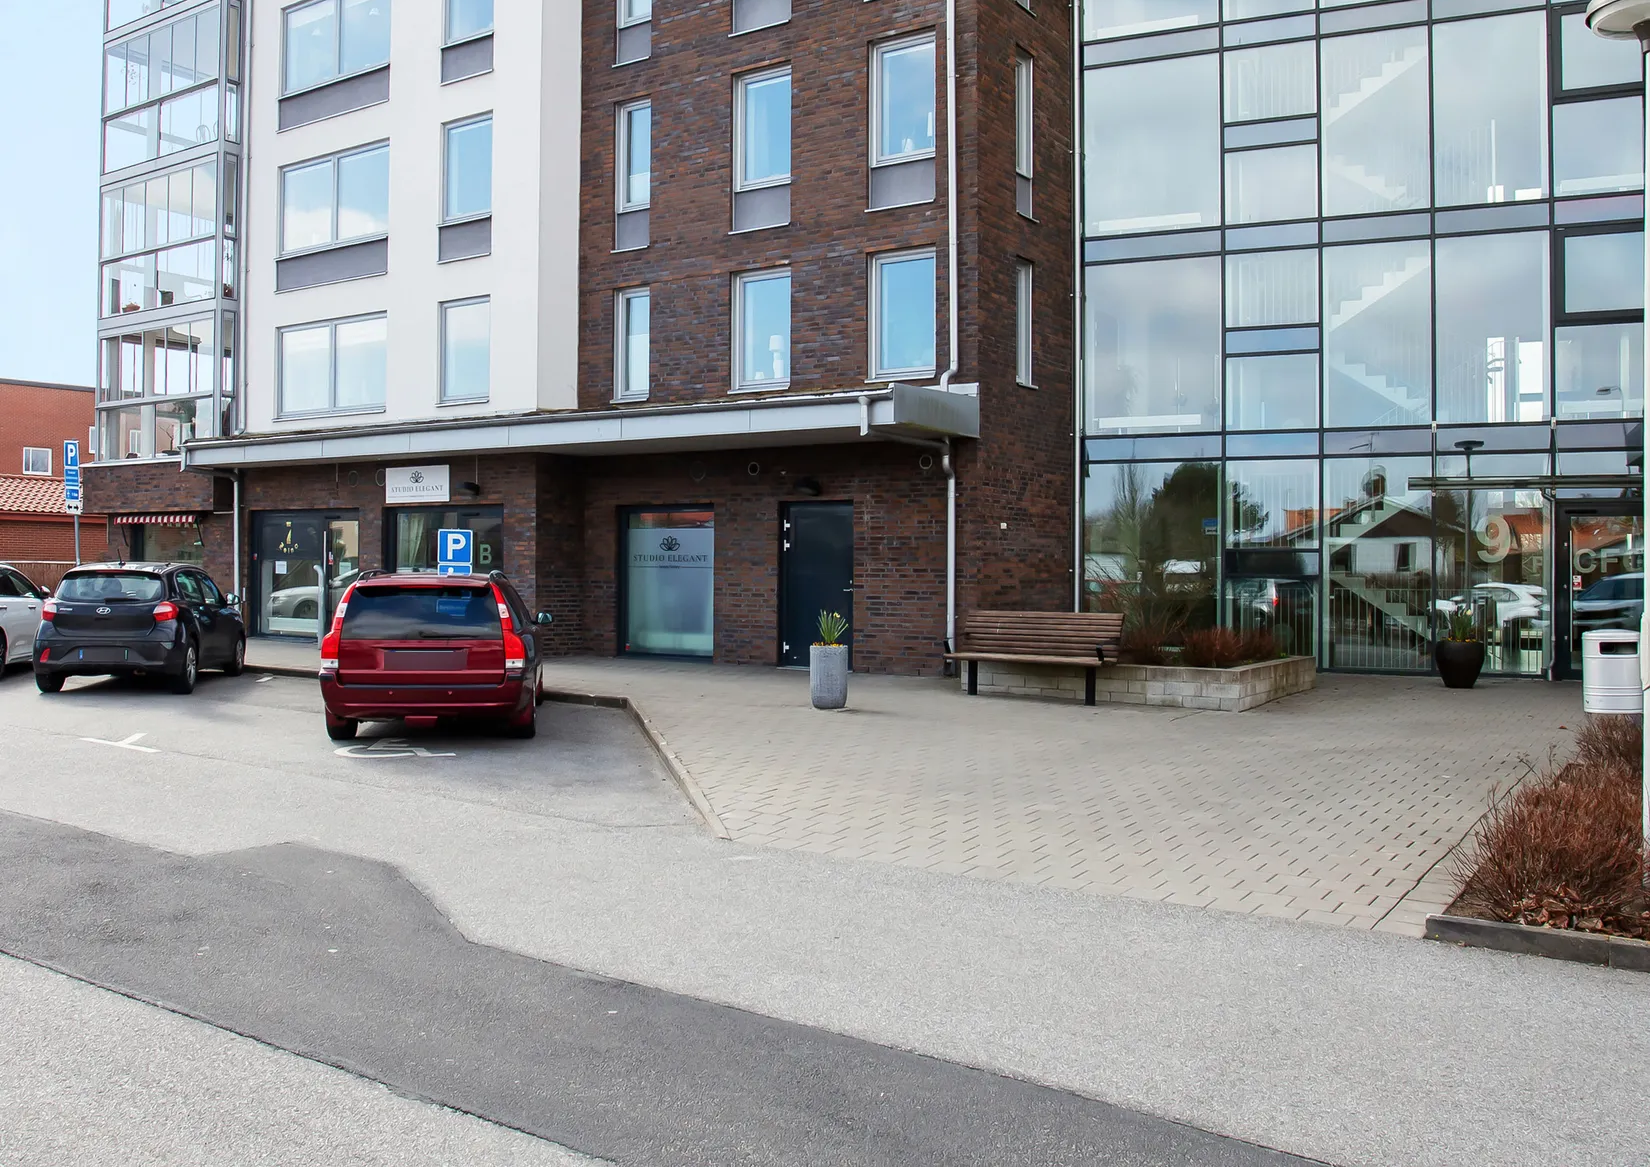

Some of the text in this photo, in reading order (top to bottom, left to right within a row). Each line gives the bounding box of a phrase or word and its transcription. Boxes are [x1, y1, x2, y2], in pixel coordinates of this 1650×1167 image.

[67, 444, 76, 465] P
[447, 533, 466, 560] P
[1476, 515, 1511, 564] 9
[479, 543, 492, 564] B
[633, 554, 708, 562] STUDIO ELEGANT
